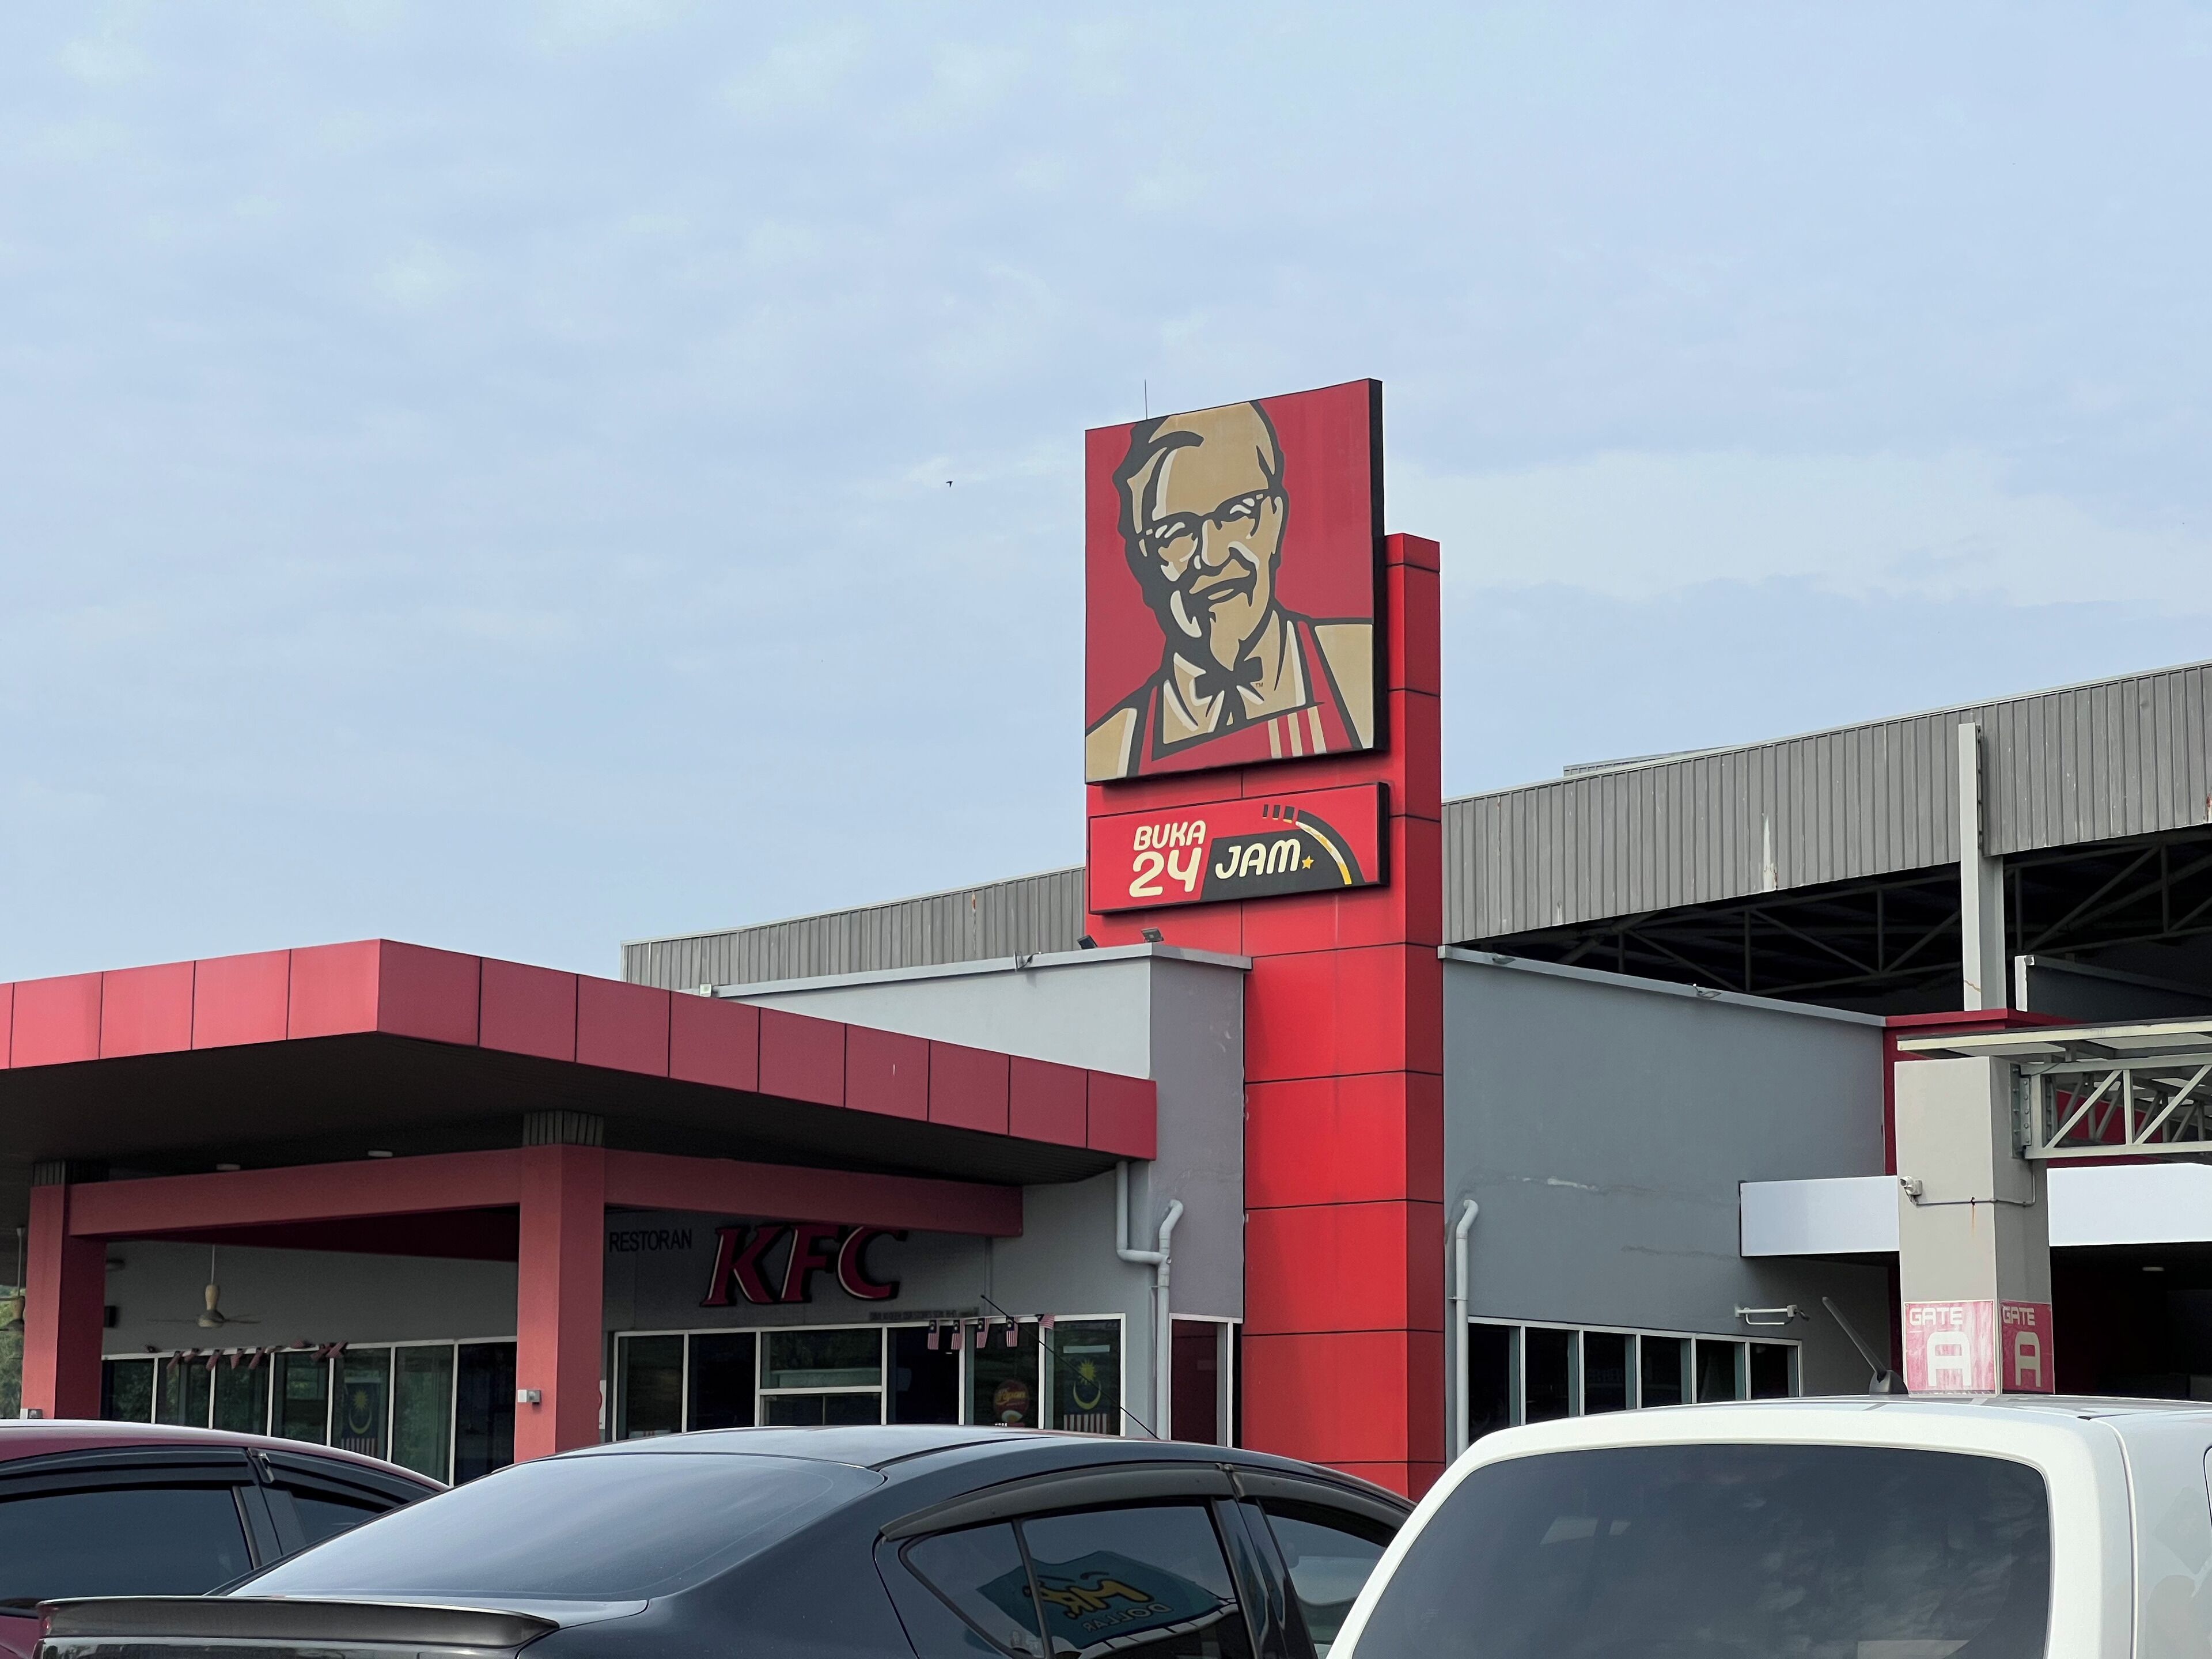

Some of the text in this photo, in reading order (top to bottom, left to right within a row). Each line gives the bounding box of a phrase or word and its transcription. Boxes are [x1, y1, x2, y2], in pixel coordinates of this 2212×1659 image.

[1133, 820, 1206, 851] BUKA
[1129, 839, 1301, 897] 24 JAM
[609, 1222, 908, 1306] RESTORAN KFC
[1909, 1306, 1963, 1325] GATE
[2002, 1306, 2036, 1325] GATE
[1926, 1331, 1972, 1387] A
[2014, 1331, 2041, 1388] A
